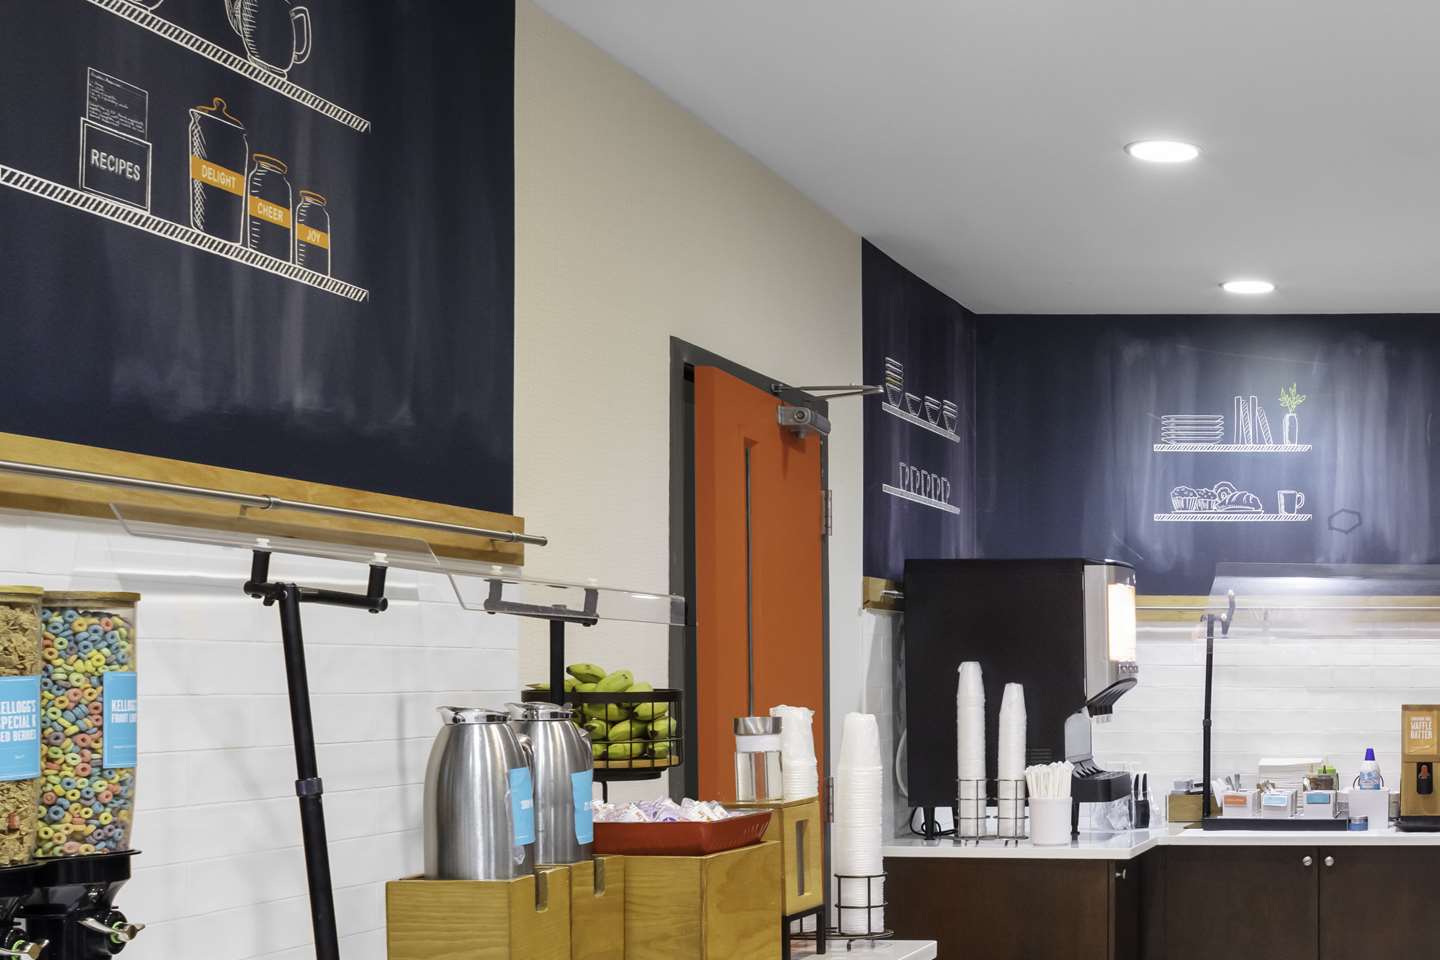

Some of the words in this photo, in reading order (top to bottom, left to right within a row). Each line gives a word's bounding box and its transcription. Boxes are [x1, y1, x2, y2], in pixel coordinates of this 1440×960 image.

[90, 149, 141, 182] RECIPES
[201, 164, 236, 189] DELIGHT
[257, 202, 284, 222] CHEER
[306, 230, 321, 243] JOY
[0, 700, 36, 715] ELLOGG'S
